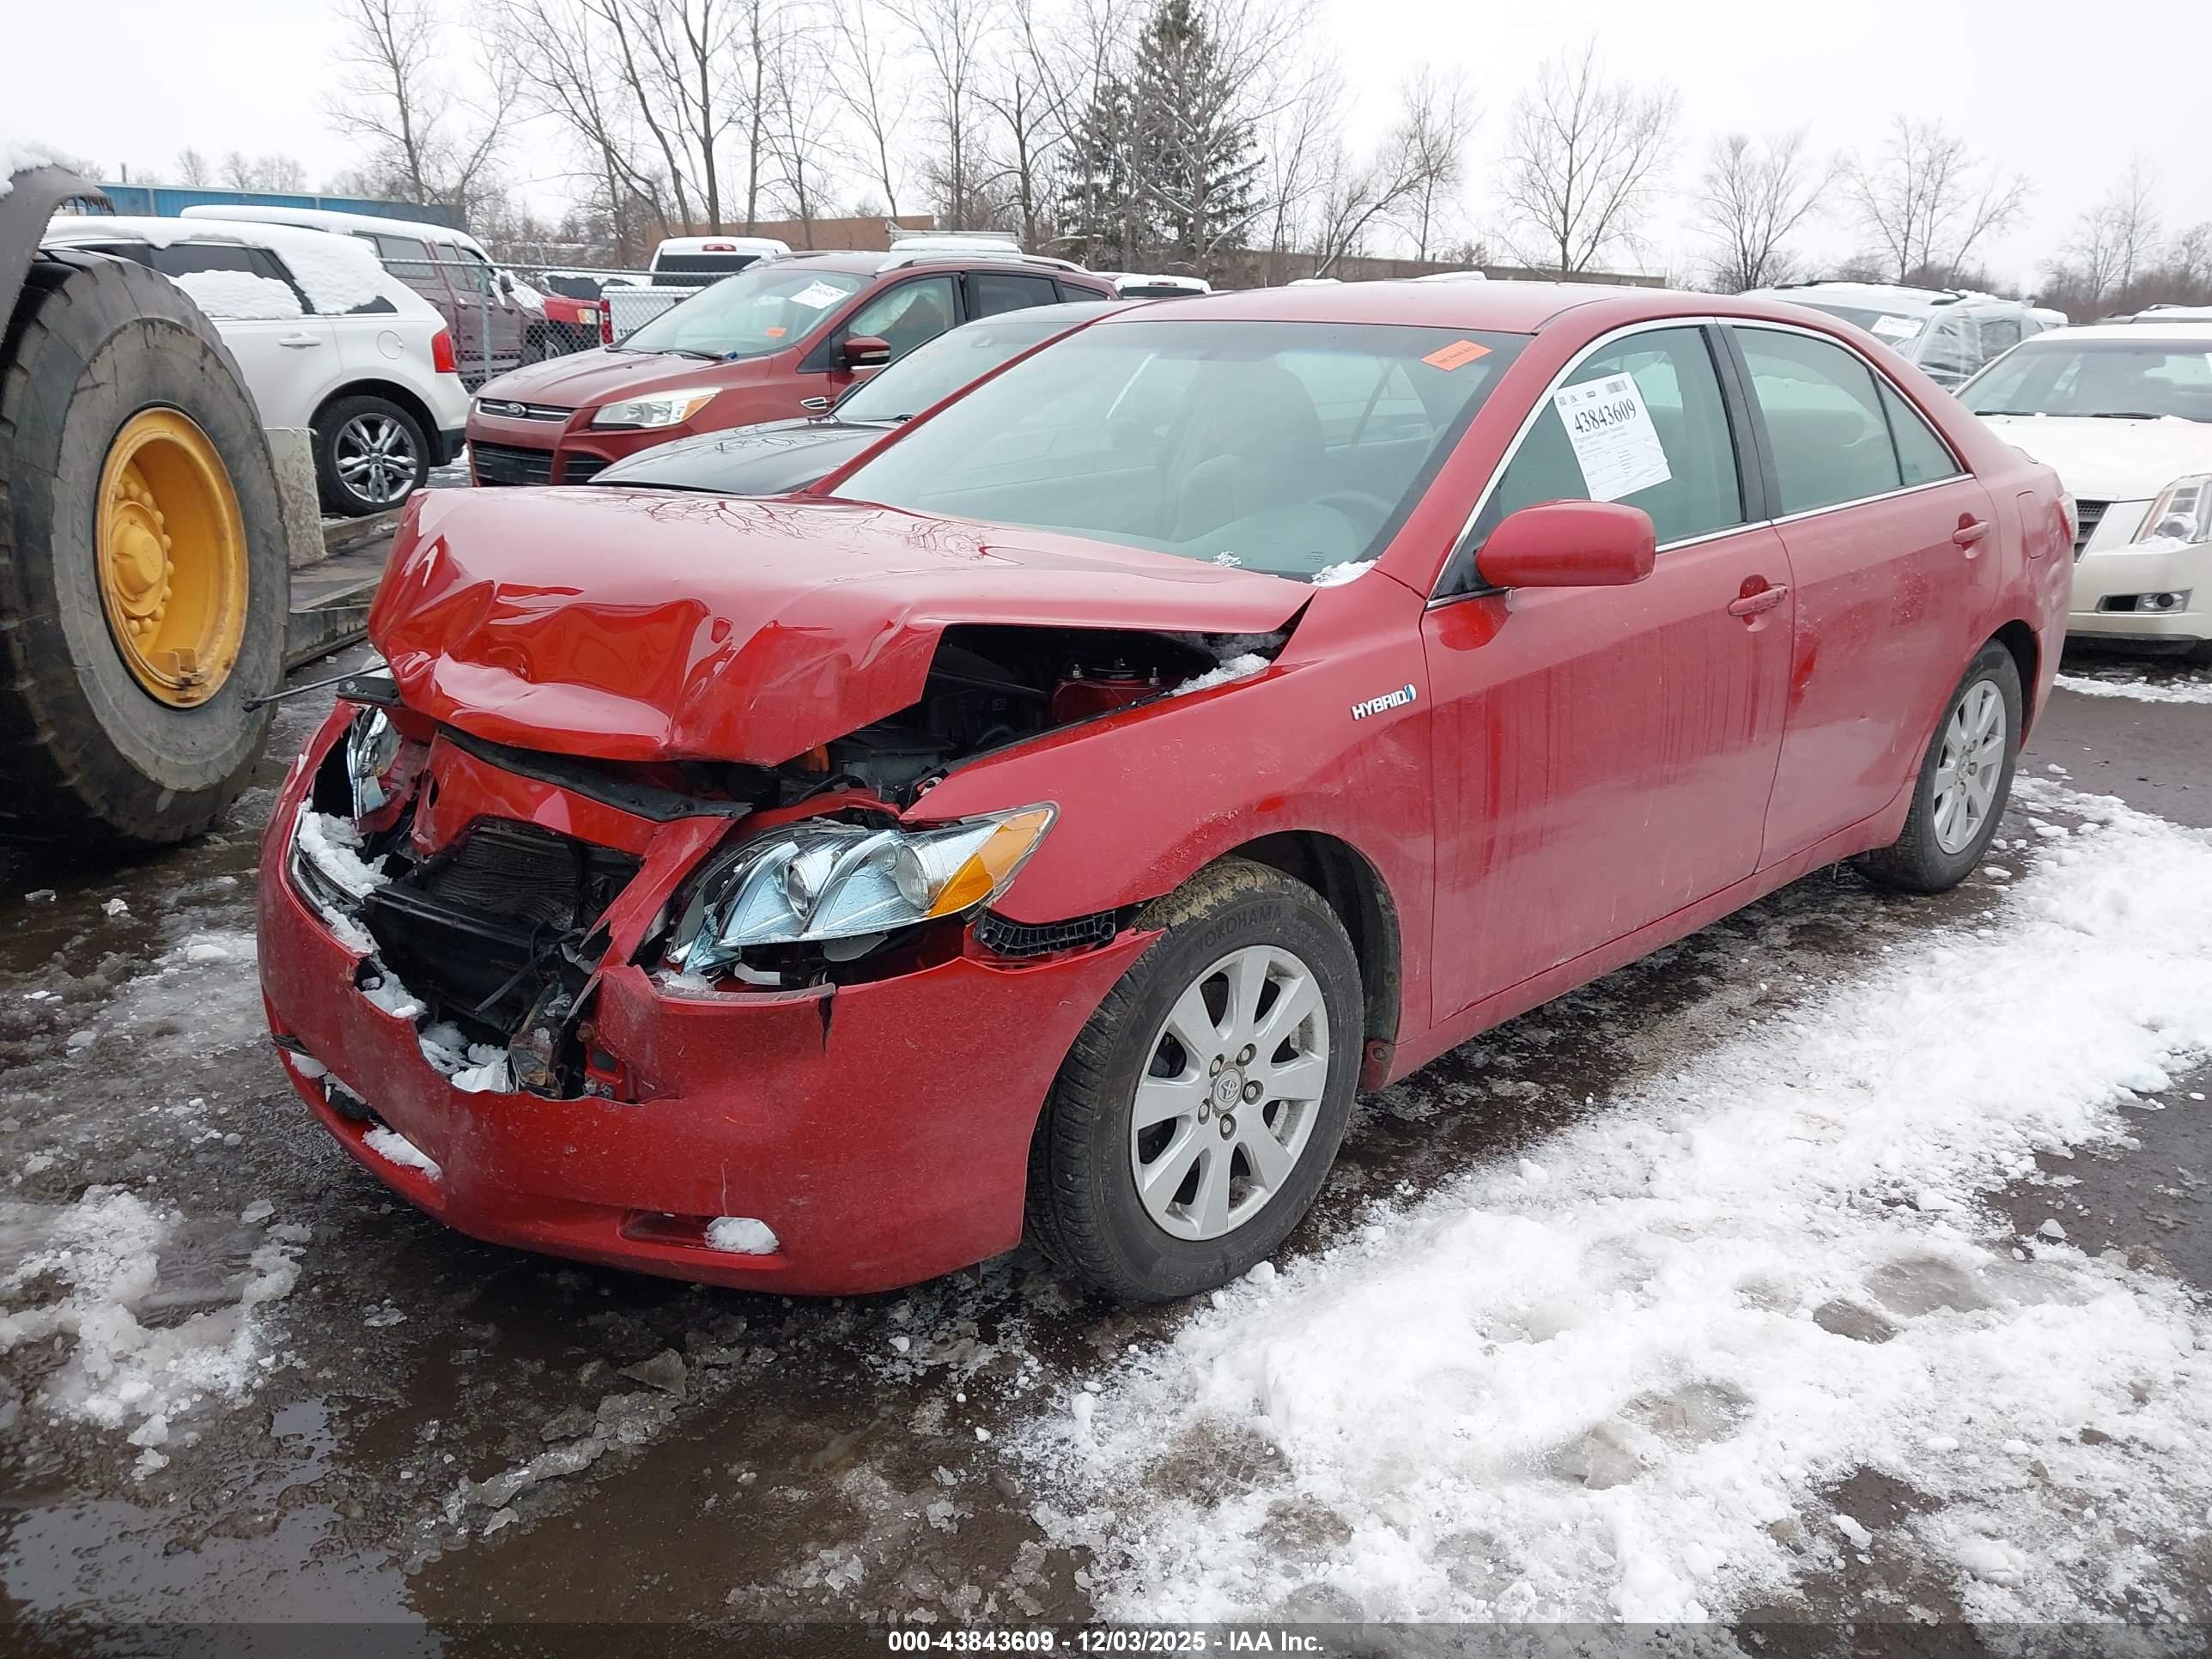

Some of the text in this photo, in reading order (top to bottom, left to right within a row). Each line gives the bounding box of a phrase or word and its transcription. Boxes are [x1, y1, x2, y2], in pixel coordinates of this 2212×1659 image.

[1573, 398, 1637, 434] 43843609
[1351, 690, 1410, 720] HYBRID
[1194, 905, 1281, 953] YOKOHAMA
